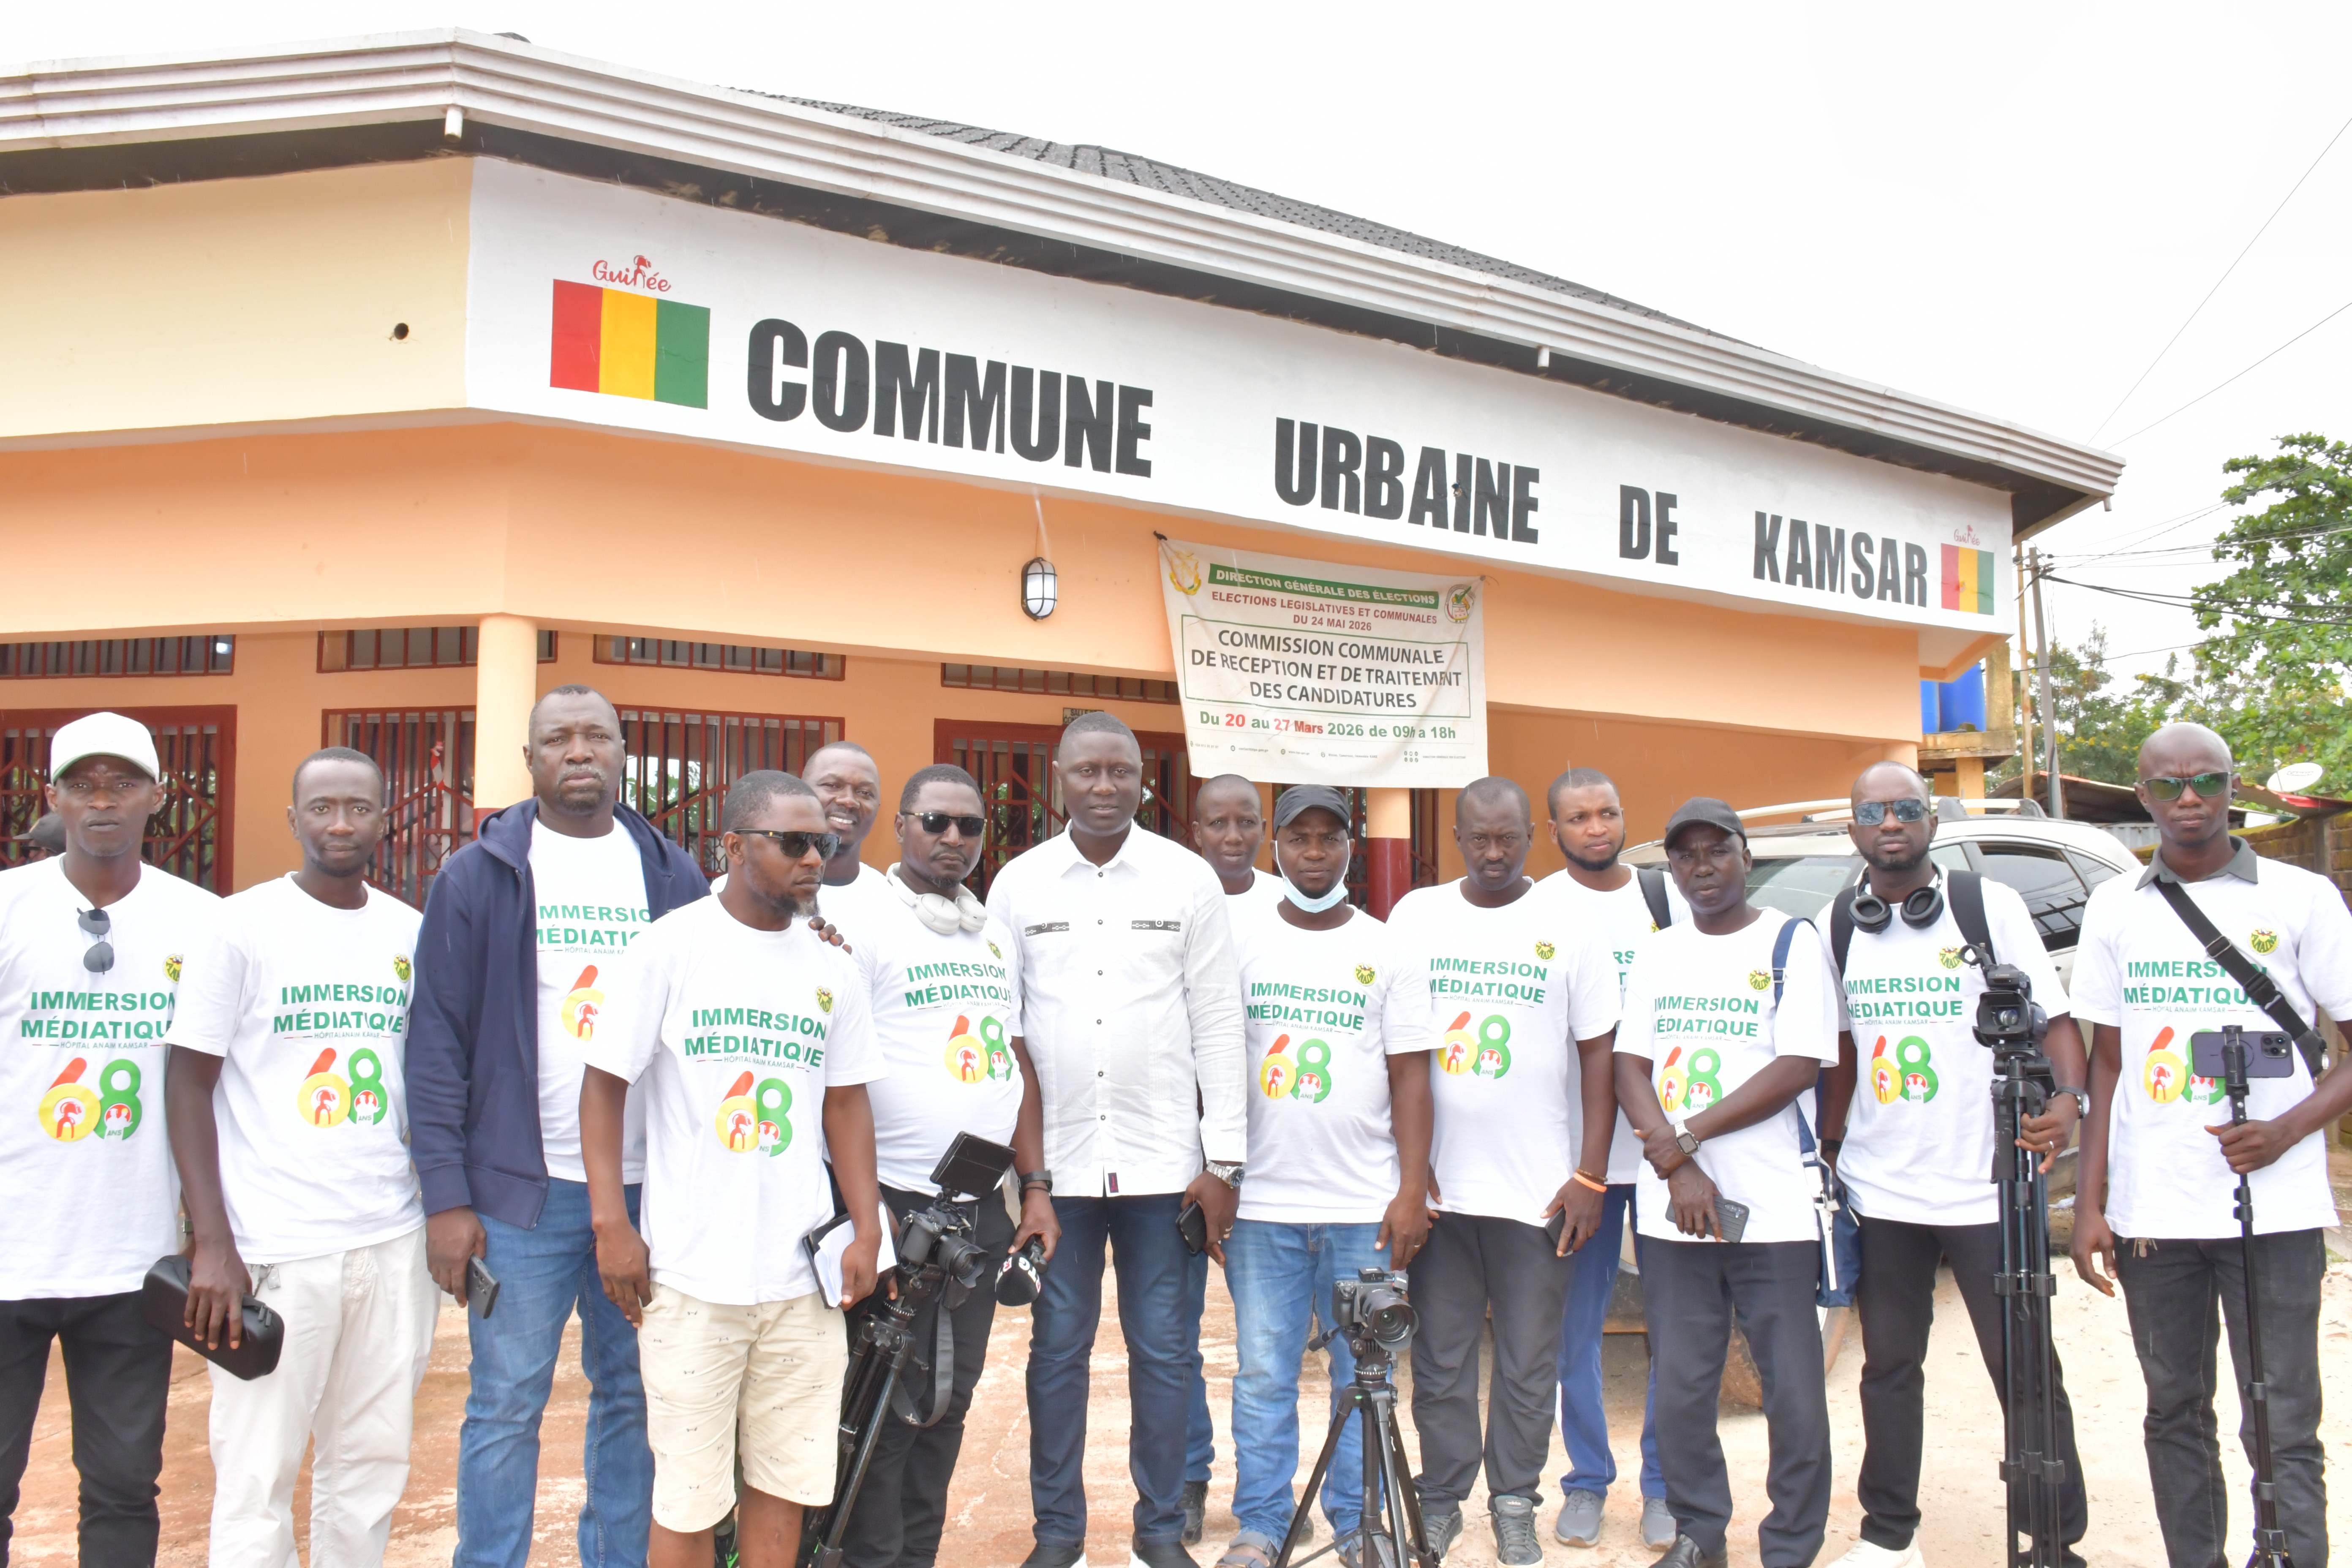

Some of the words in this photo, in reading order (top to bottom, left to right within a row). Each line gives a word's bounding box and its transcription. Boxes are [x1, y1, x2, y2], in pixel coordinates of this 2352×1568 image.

[748, 318, 1153, 478] COMMUNE
[1274, 416, 1539, 544] URBAINE
[1620, 484, 1678, 566] DE
[1753, 510, 1927, 607] KAMSAR
[1217, 570, 1281, 588] DIRECTION
[1284, 580, 1345, 596] GÉNÉRALE
[1348, 589, 1370, 599] DES
[1373, 590, 1435, 604] ÉLECTIONS
[1212, 591, 1277, 607] ELECTIONS
[1281, 599, 1355, 615] LEGISLATIVES
[1358, 608, 1370, 617] ET
[1374, 610, 1437, 624] COMMUNALES
[1293, 615, 1307, 624] DU
[1312, 617, 1323, 626] 24
[1327, 618, 1345, 628] MAI
[1349, 621, 1372, 631] 2026
[1218, 630, 1334, 656] COMMISSION
[1339, 642, 1444, 664] COMMUNALE
[1192, 649, 1216, 667] DE
[1220, 653, 1312, 678] RECEPTION
[1317, 664, 1337, 680] ET
[1341, 667, 1361, 683] DE
[1365, 668, 1461, 686] TRAITEMENT
[1250, 681, 1282, 699] DES
[1287, 685, 1417, 708] CANDIDATURES
[1200, 711, 1219, 725] Du
[1225, 713, 1245, 727] 20
[1251, 719, 1269, 729] au
[1274, 719, 1290, 731] 27
[1294, 721, 1323, 734] Mars
[1328, 723, 1364, 736] 2026
[1369, 725, 1387, 737] de
[1393, 726, 1415, 738] 09h
[1418, 729, 1425, 738] a
[1431, 727, 1455, 738] 18h
[539, 905, 651, 923] MMERSIO
[537, 924, 640, 946] ÉDIATI
[2251, 934, 2277, 953] ANAIM
[1535, 944, 1555, 960] ANAIM
[907, 962, 1006, 982] IMMERSION
[1356, 968, 1375, 984] ANAIM
[1430, 958, 1547, 981] IMMERSION
[2128, 961, 2267, 978] IMMERSI
[1429, 975, 1545, 1004] MÉDIATIQUE
[1749, 973, 1771, 990] ANAIM
[1845, 977, 1960, 995] IMMERSION
[282, 984, 407, 1007] IMMERSION
[1251, 983, 1366, 1008] IMMERSION
[1655, 996, 1759, 1014] IMMERSION
[2123, 983, 2260, 1006] MÉDIATIQU
[1247, 1001, 1364, 1031] MÉDIATIQUE
[1847, 1000, 1963, 1018] MÉDIATIQUE
[21, 1016, 172, 1040] MÉDIATIQU
[693, 1008, 827, 1041] IMMERSION
[1272, 1020, 1289, 1028] ÔPITAL
[685, 1032, 824, 1067] MÉDIATIQUE
[768, 1060, 794, 1069] KAMSAR
